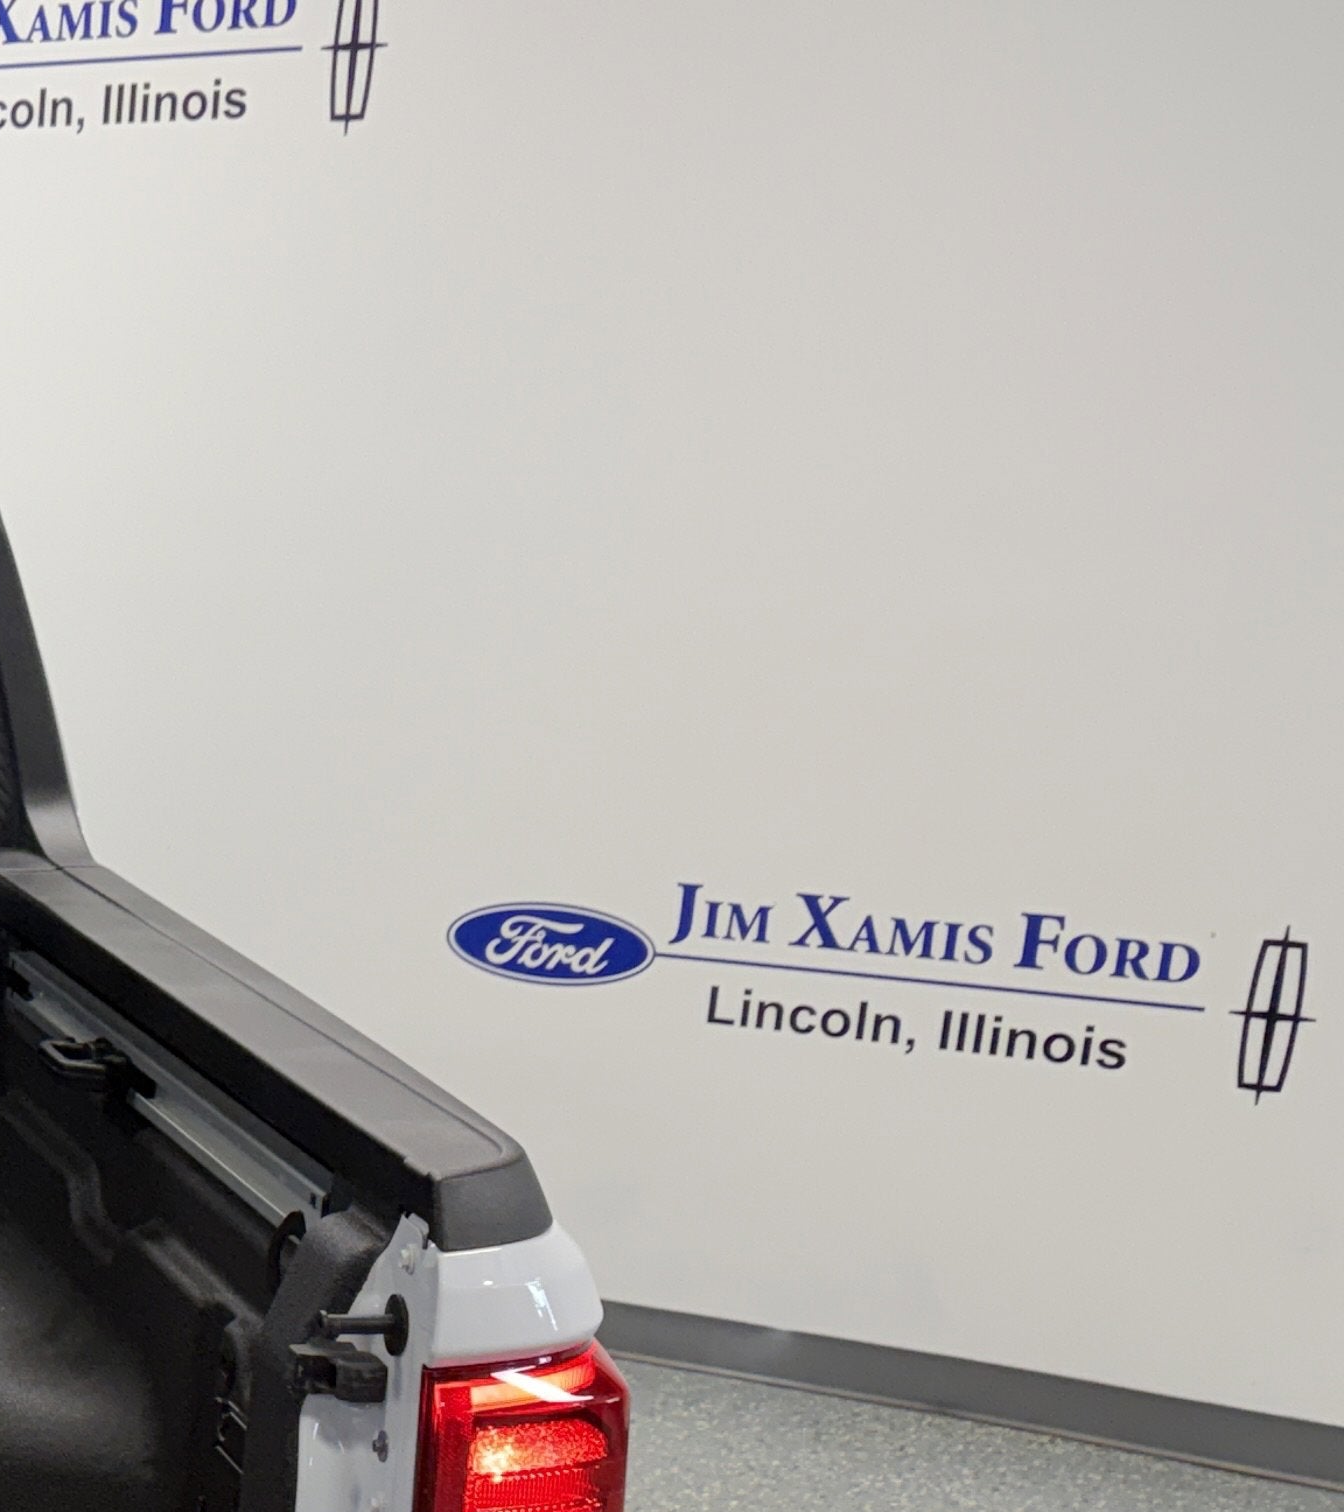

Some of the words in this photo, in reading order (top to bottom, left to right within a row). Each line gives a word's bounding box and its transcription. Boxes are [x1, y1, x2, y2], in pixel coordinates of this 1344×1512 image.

[154, 0, 297, 35] FORD
[103, 78, 246, 124] Illinois
[484, 915, 612, 977] Ford
[668, 882, 773, 945] JIM
[794, 893, 994, 965] XAMIS
[1013, 912, 1200, 983] FORD
[706, 985, 917, 1056] Lincoln,
[938, 1009, 1129, 1071] Illinois
